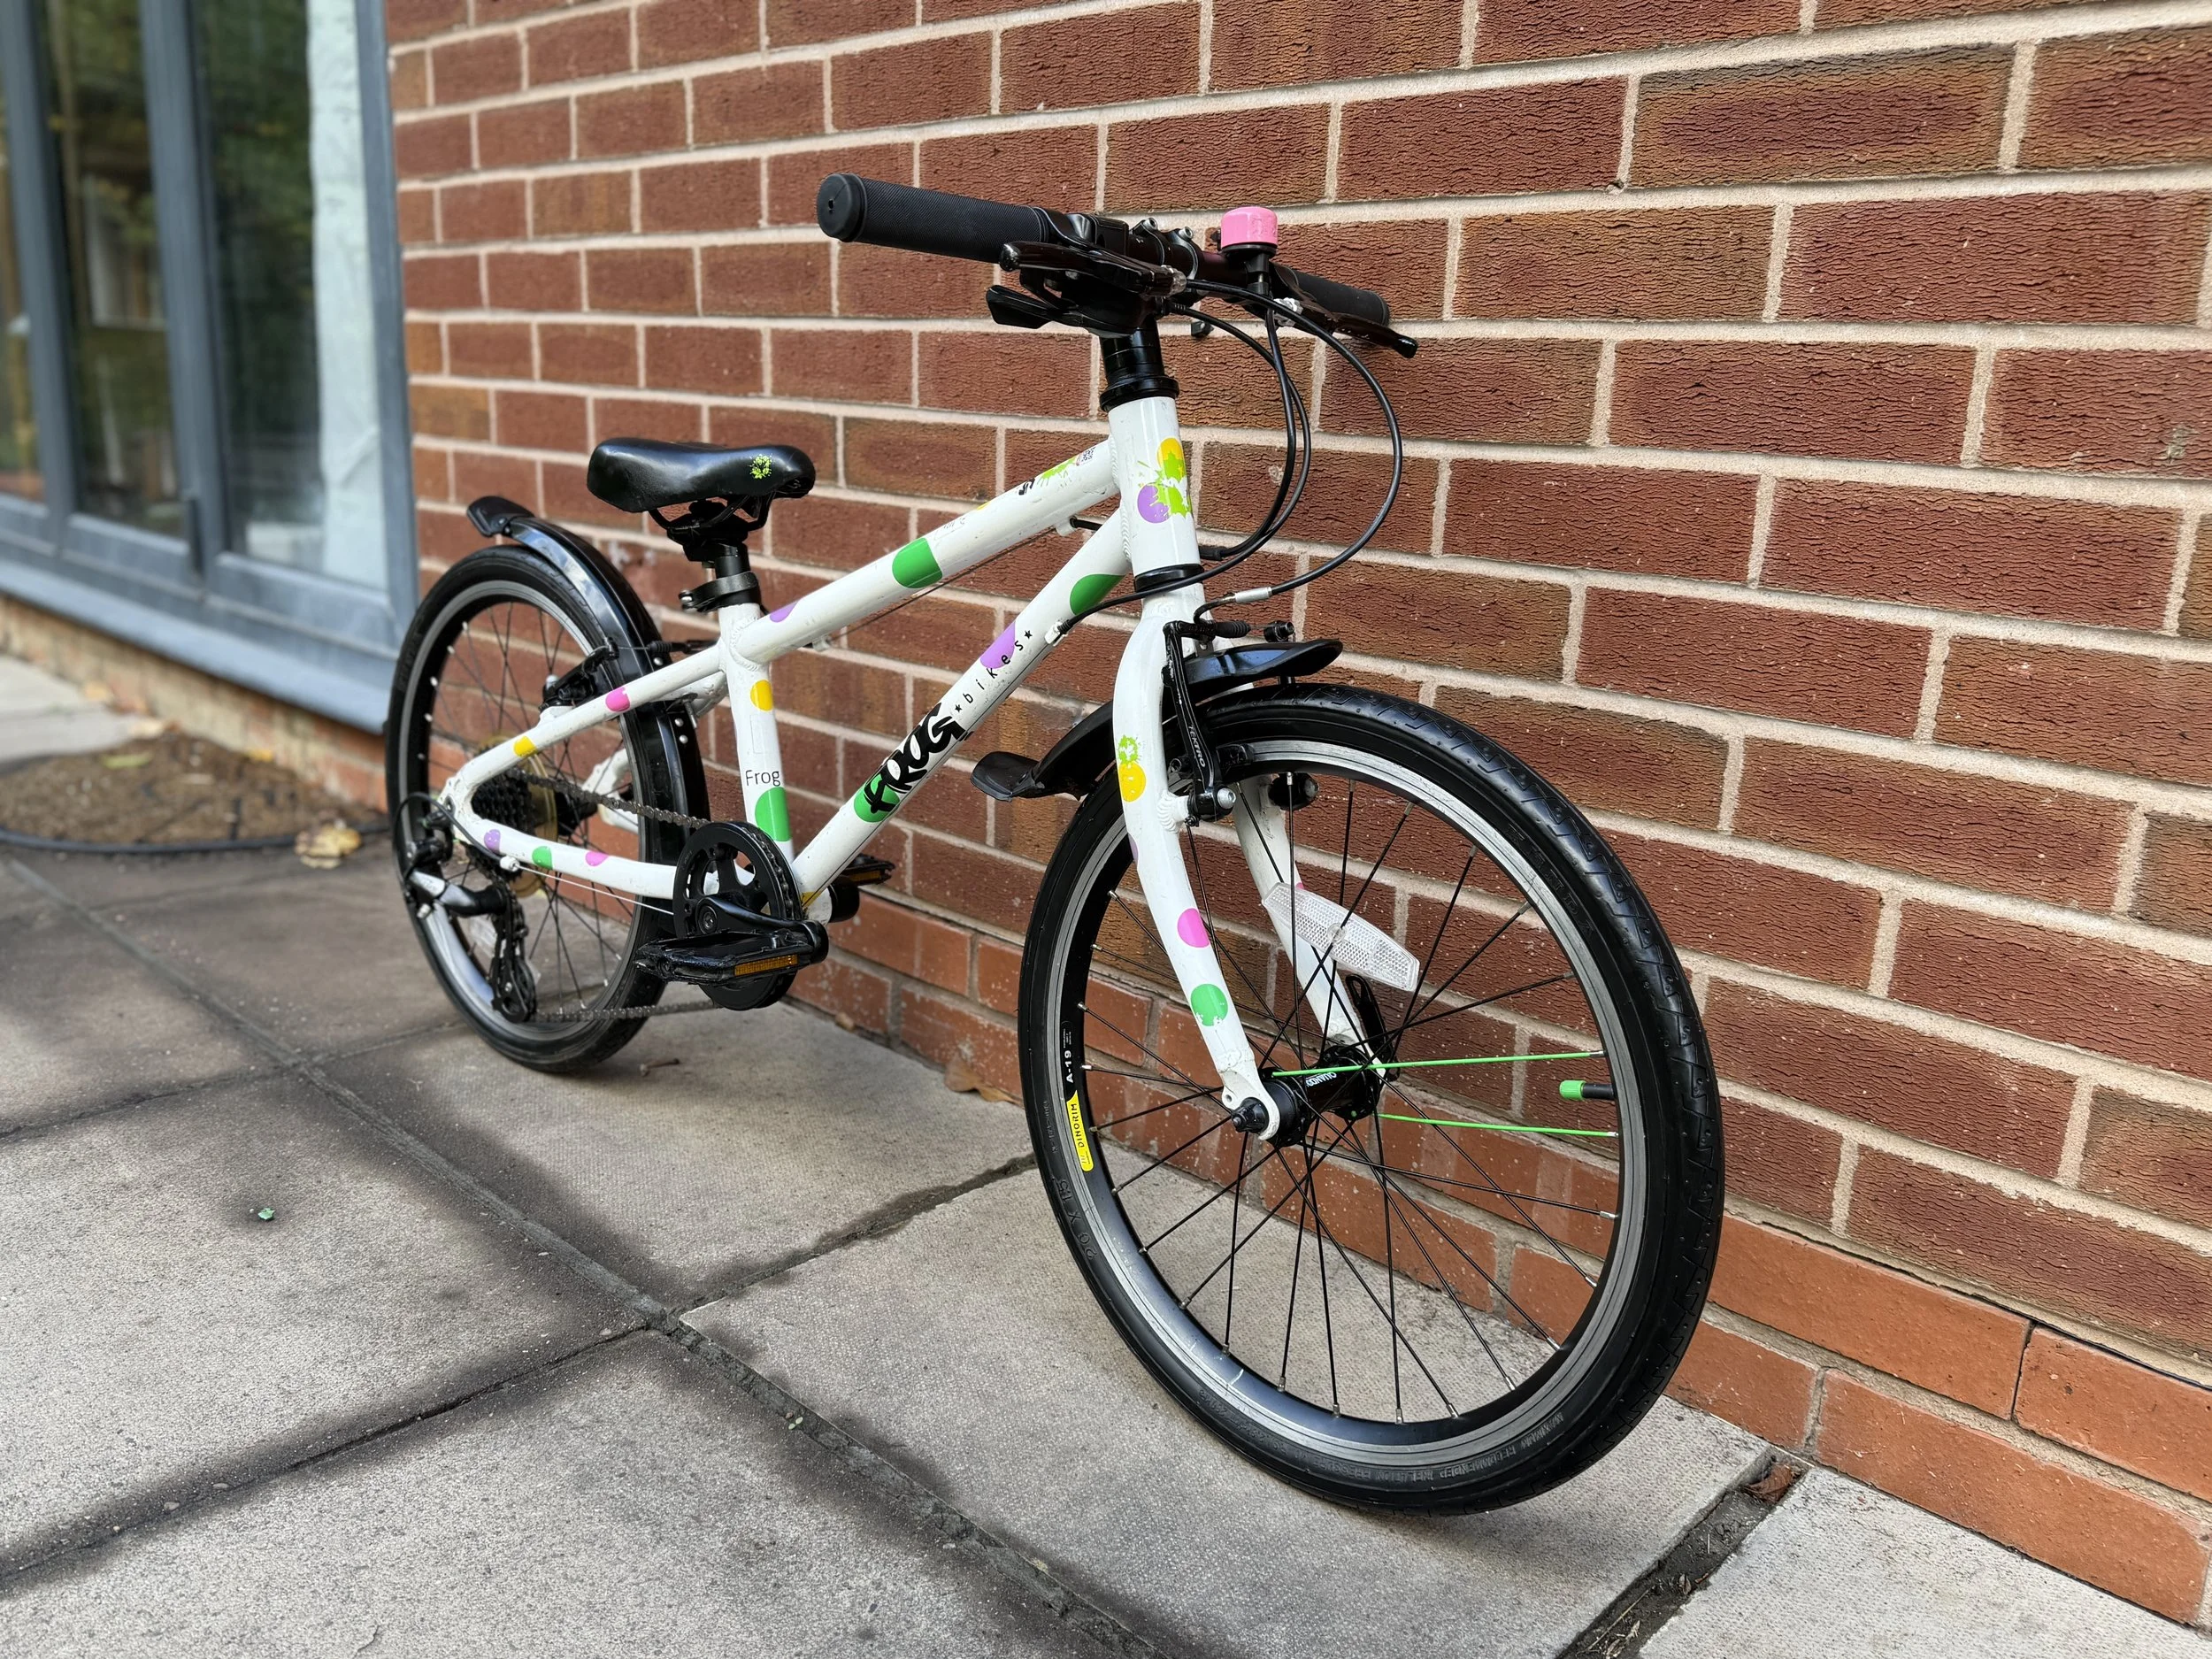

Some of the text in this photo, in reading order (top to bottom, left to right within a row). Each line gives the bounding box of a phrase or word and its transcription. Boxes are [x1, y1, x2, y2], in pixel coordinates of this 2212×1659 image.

[962, 640, 1024, 704] bikes
[864, 702, 966, 813] FROG
[1188, 726, 1205, 767] TEKTRO
[745, 770, 781, 787] Frog
[1064, 1049, 1074, 1084] A-19
[1071, 1102, 1085, 1148] DINORIM
